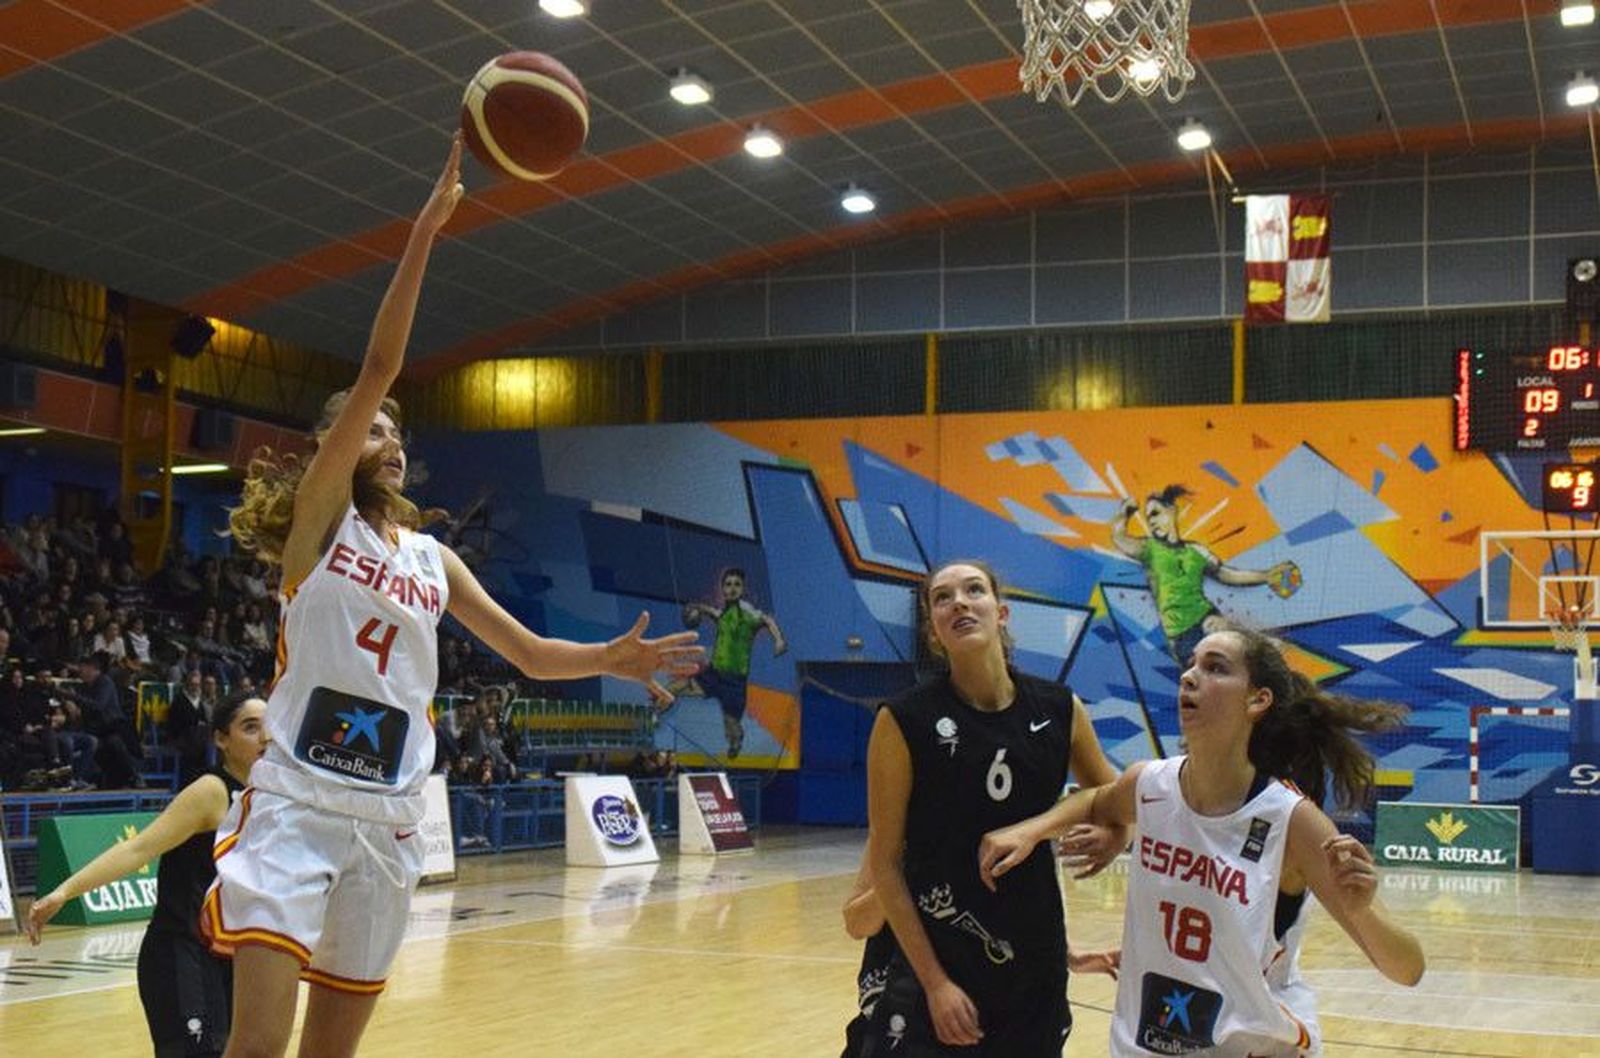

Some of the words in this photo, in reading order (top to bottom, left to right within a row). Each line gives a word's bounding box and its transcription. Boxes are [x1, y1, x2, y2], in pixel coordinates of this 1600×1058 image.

[1549, 348, 1600, 370] 06:
[1517, 376, 1555, 387] LOCAL
[1525, 390, 1559, 413] 09
[1525, 419, 1539, 436] 2
[1573, 487, 1589, 507] 9
[326, 543, 440, 616] ESPAÑA
[355, 617, 399, 677] 4
[308, 744, 386, 783] CaixaBank
[986, 748, 1013, 801] 6
[1383, 844, 1432, 862] CAJA
[1437, 846, 1507, 865] RURAL
[1140, 836, 1250, 906] ESPAÑA
[83, 880, 143, 912] CAJA
[1159, 900, 1213, 963] 18
